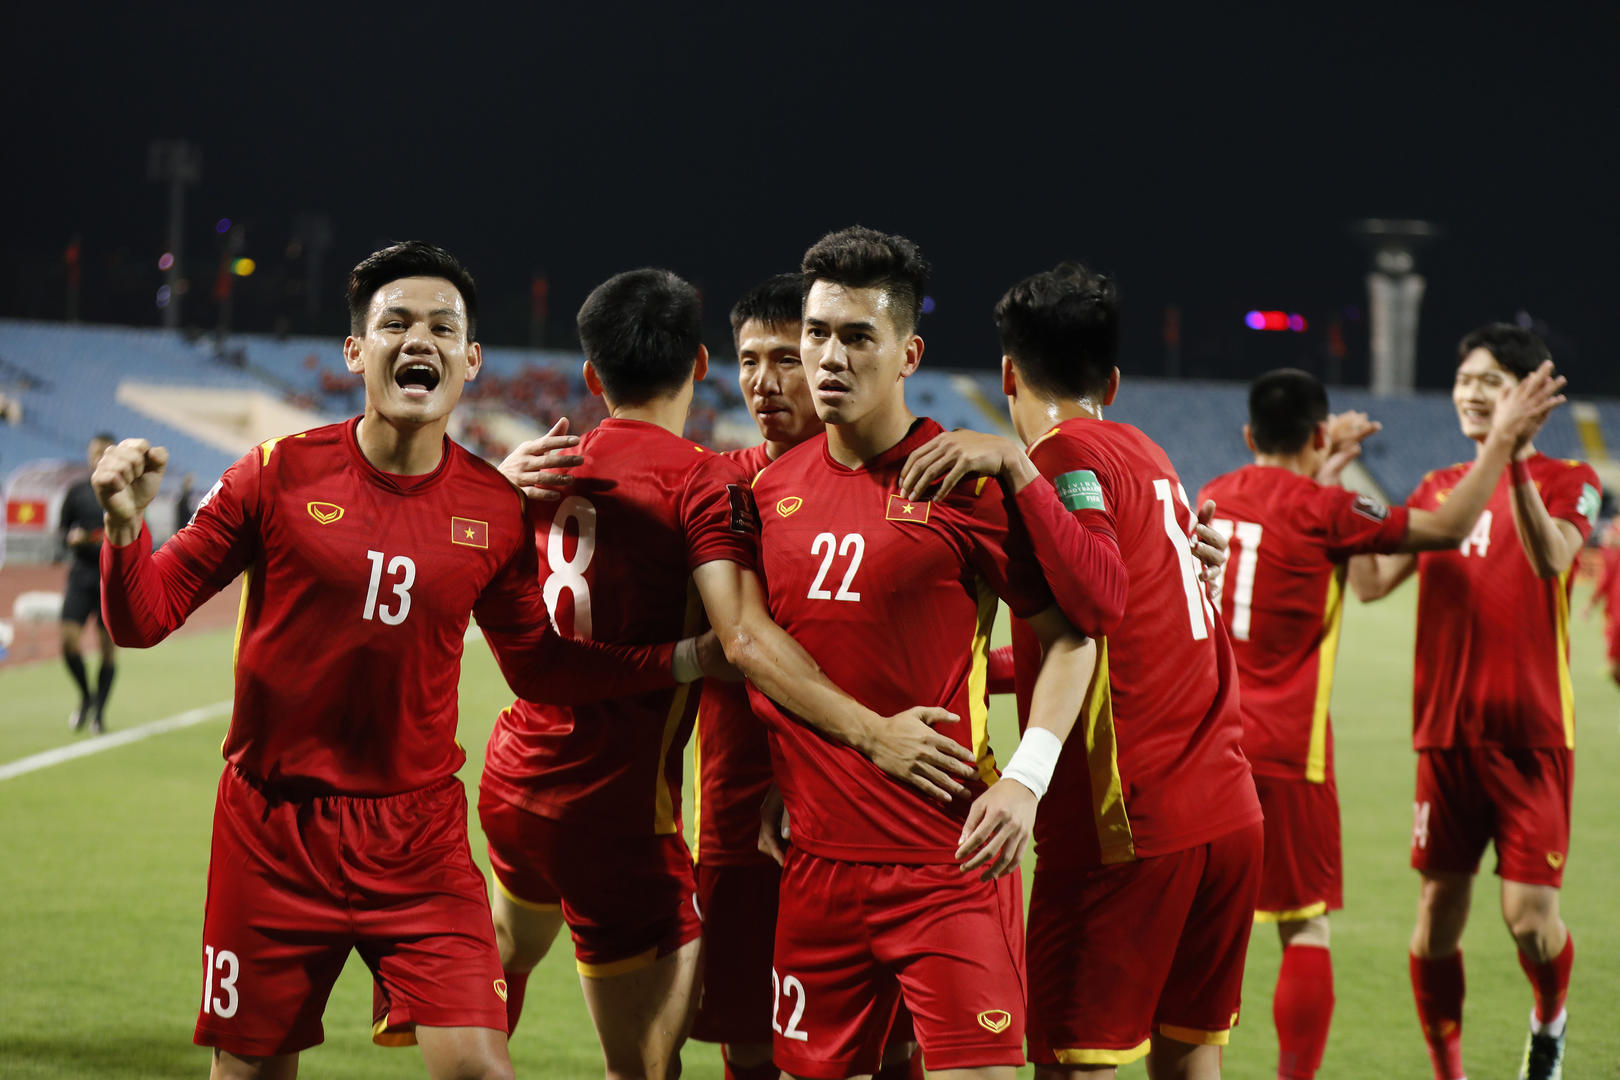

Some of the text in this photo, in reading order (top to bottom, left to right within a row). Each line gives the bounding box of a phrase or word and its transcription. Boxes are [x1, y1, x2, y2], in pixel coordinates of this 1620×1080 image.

[362, 549, 416, 626] 13
[542, 495, 597, 641] 8
[807, 532, 866, 602] 22
[203, 944, 240, 1019] 13
[771, 965, 808, 1042] 22
